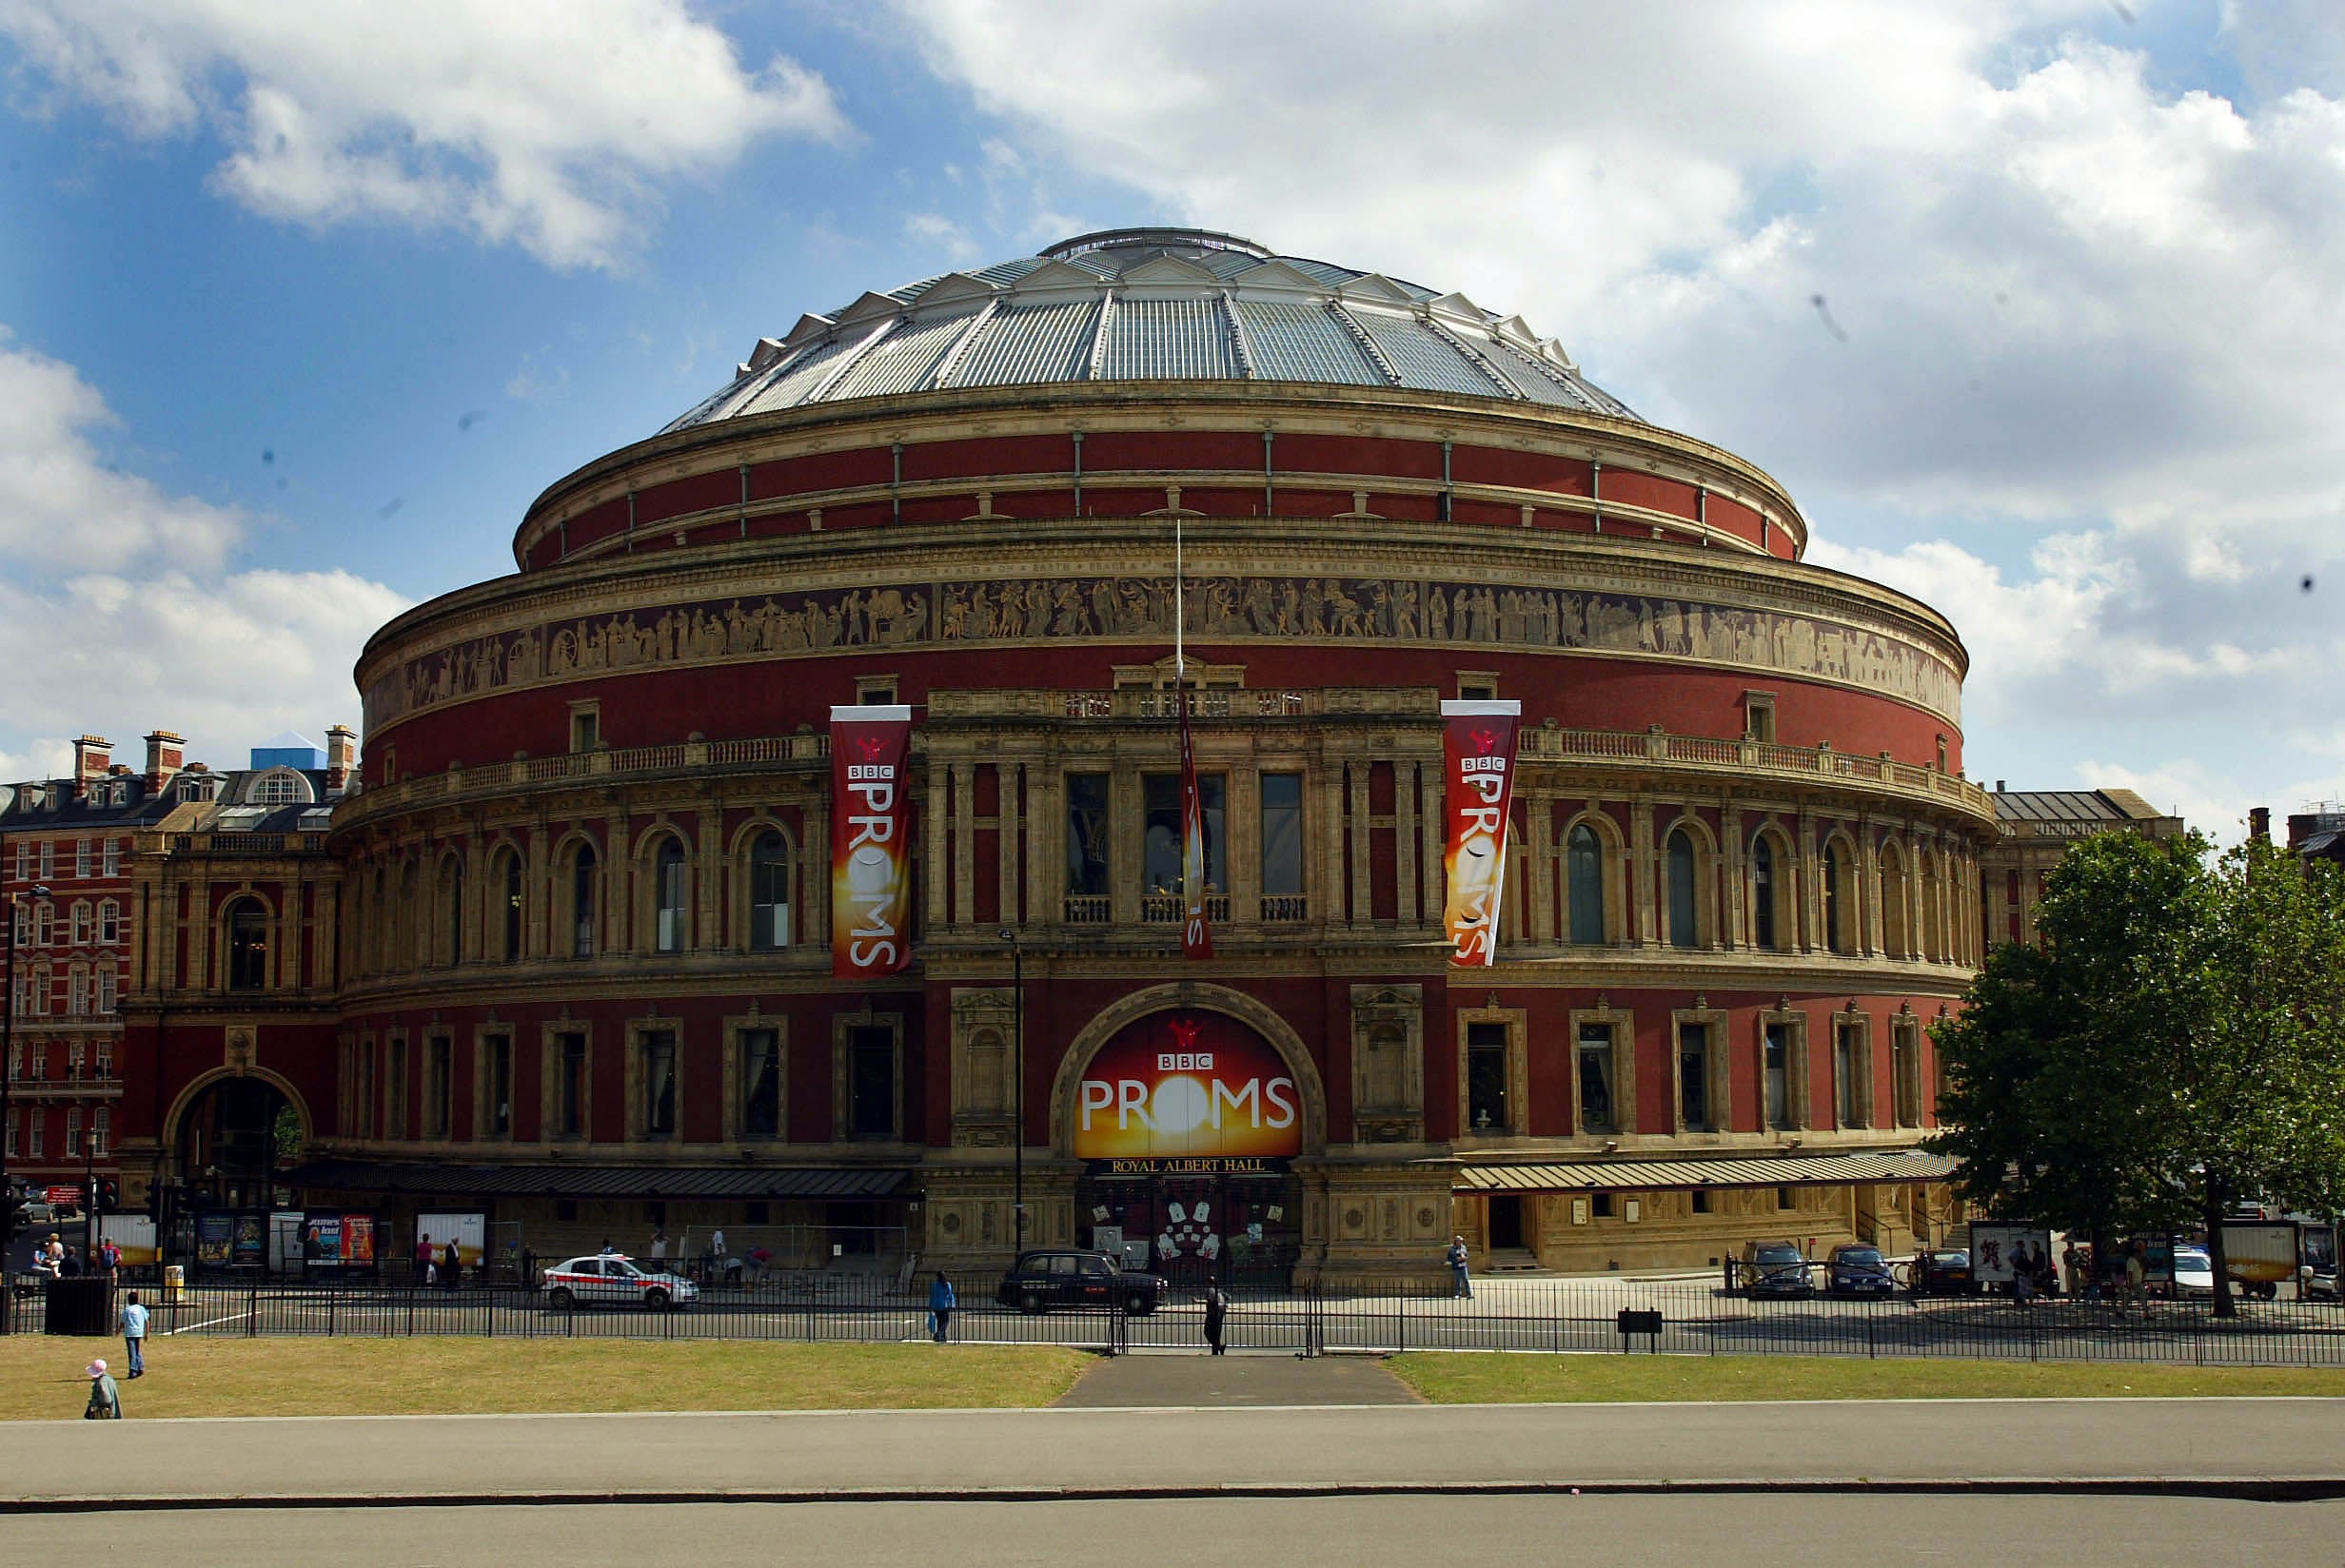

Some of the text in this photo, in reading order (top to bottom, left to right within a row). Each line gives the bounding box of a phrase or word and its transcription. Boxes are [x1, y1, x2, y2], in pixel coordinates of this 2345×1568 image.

[849, 766, 894, 778] BBC
[1462, 757, 1505, 772] BBC
[848, 783, 897, 967] PROMS
[1452, 774, 1504, 959] PROMS
[1158, 1053, 1213, 1070] BBC
[1081, 1076, 1296, 1131] PROMS
[1113, 1159, 1265, 1173] ROYAL ALBERT HALL
